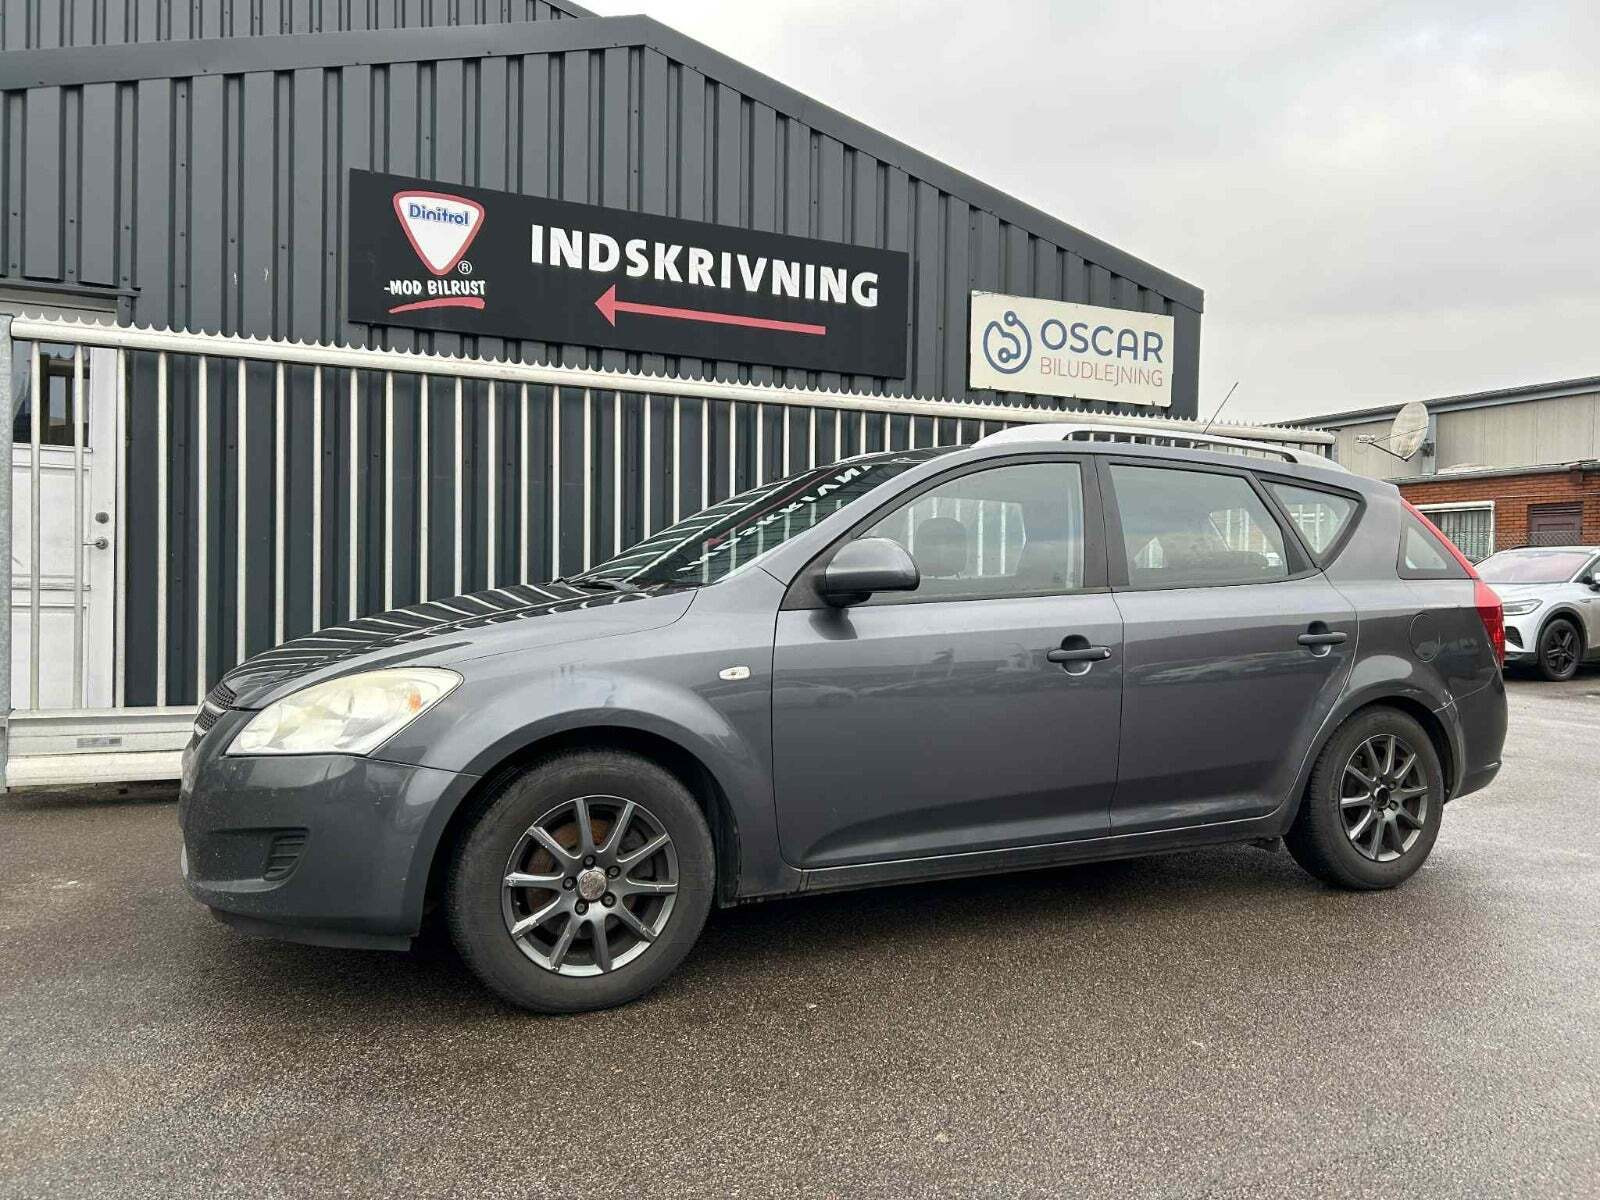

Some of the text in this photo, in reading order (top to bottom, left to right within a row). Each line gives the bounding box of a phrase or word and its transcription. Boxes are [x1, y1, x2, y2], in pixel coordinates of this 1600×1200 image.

[409, 203, 469, 225] Dinitrol
[531, 224, 879, 307] INDSKRIVNING
[427, 280, 485, 295] BILRUST
[1040, 319, 1163, 363] OSCAR
[1040, 357, 1163, 387] BILUDLEJNING
